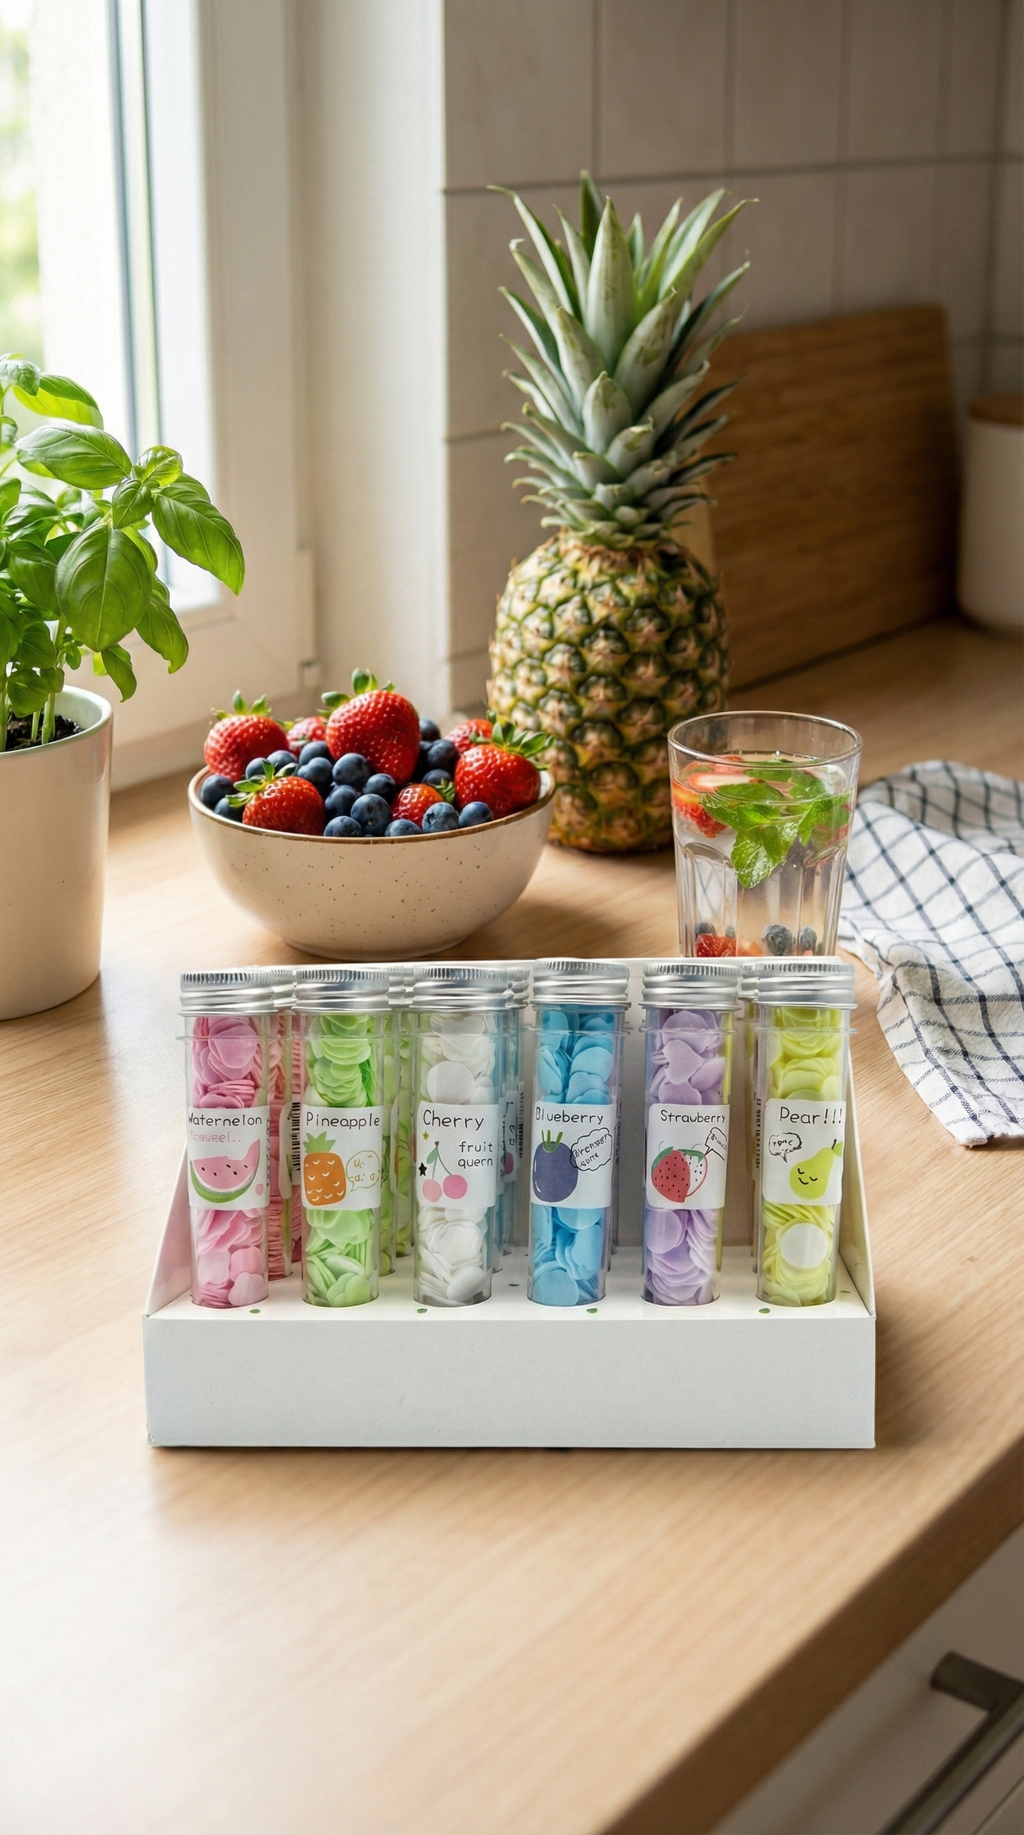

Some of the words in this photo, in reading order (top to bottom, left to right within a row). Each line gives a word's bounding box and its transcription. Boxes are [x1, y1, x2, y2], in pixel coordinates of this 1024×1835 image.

[306, 1111, 380, 1130] Pineapple
[422, 1109, 484, 1131] Cherry
[535, 1106, 604, 1125] Blueberry
[780, 1106, 842, 1124] Pear!!!
[459, 1140, 493, 1153] fruit
